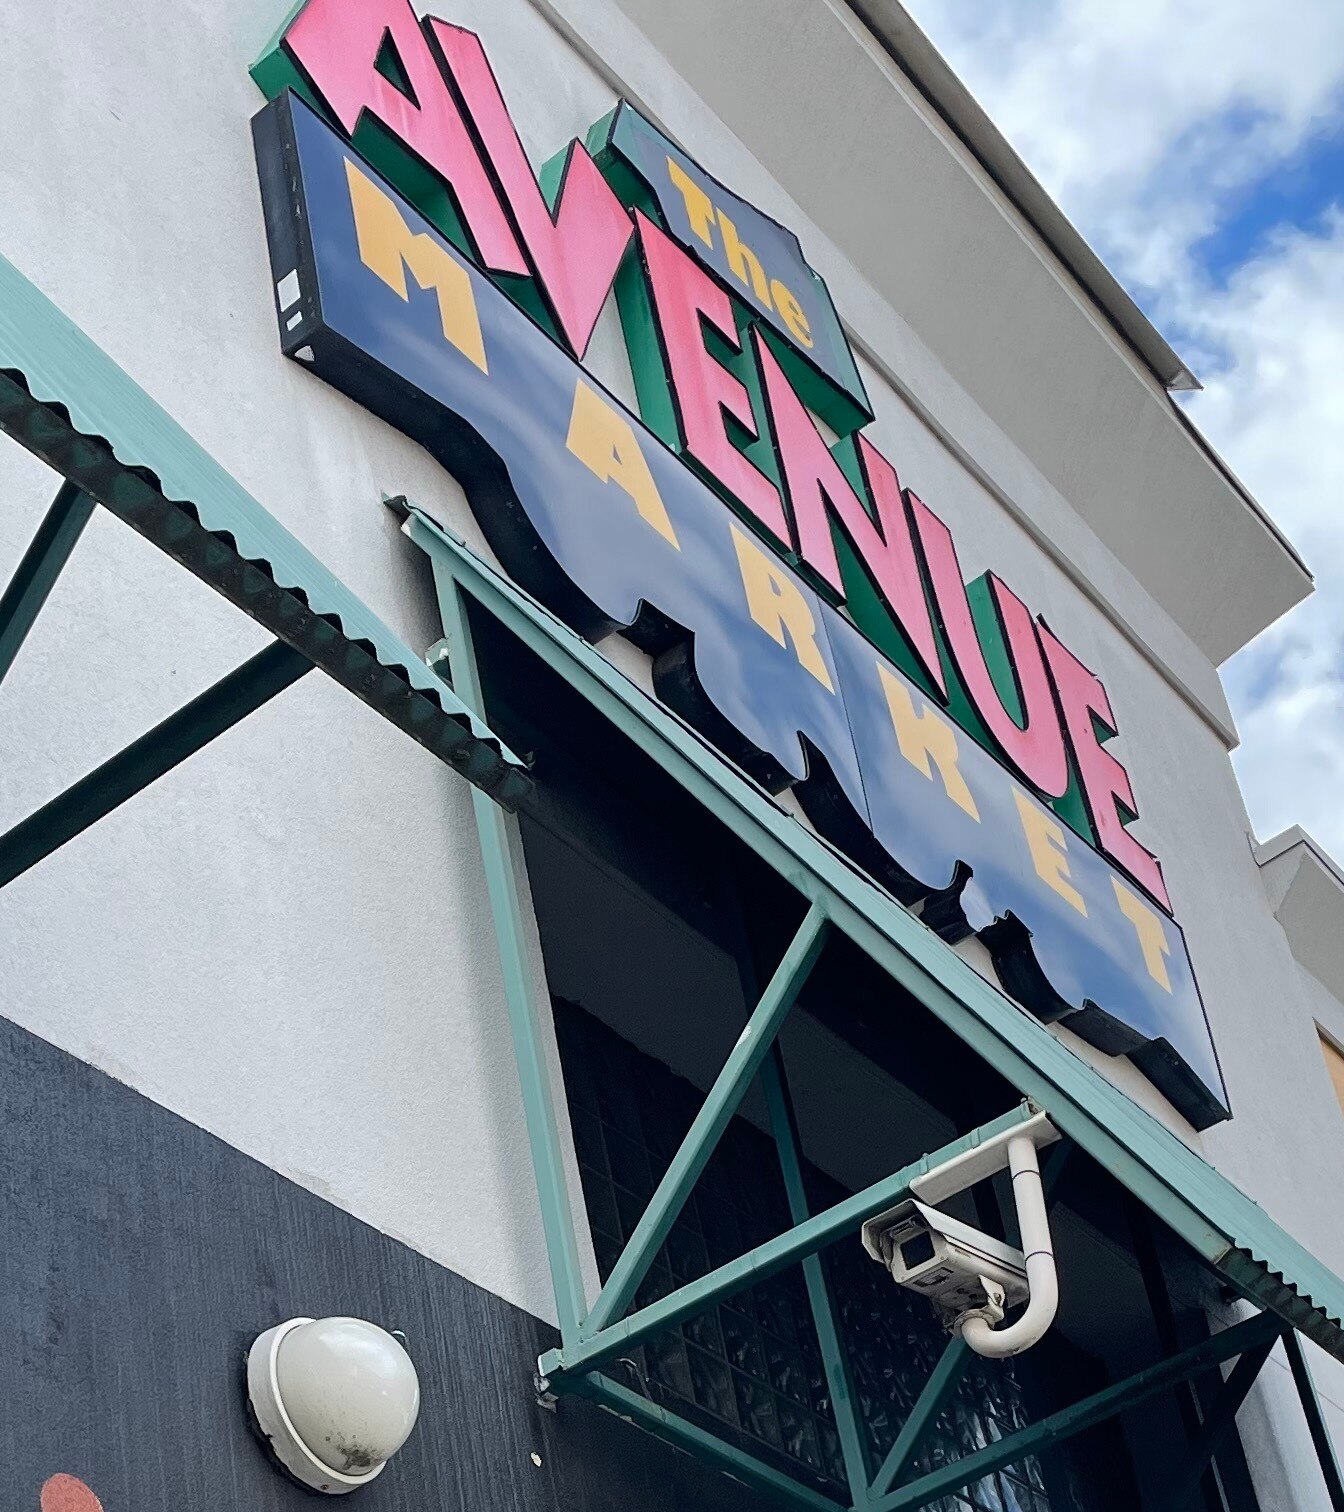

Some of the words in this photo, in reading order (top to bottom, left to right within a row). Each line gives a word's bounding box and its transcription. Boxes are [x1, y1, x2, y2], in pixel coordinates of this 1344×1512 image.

[280, 0, 1175, 918] AVENUE
[343, 155, 1174, 996] MARKET
[666, 155, 816, 349] The
